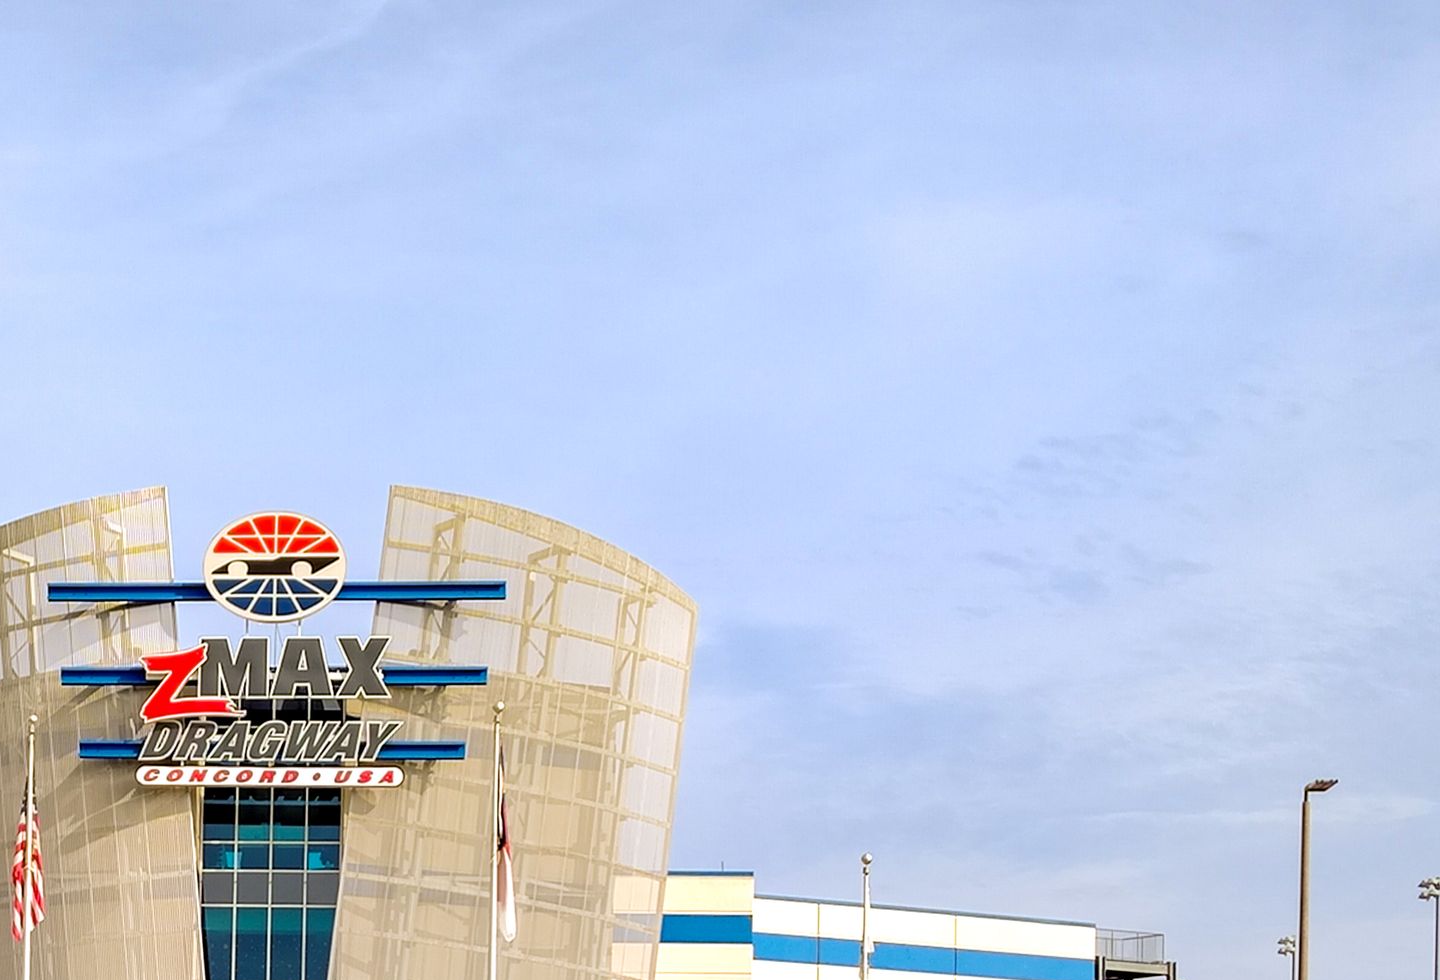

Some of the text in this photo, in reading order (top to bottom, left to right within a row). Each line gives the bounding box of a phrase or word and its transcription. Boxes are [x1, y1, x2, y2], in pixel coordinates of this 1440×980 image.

[138, 719, 404, 762] DRAGWAY
[143, 769, 394, 783] CONCORD USA
